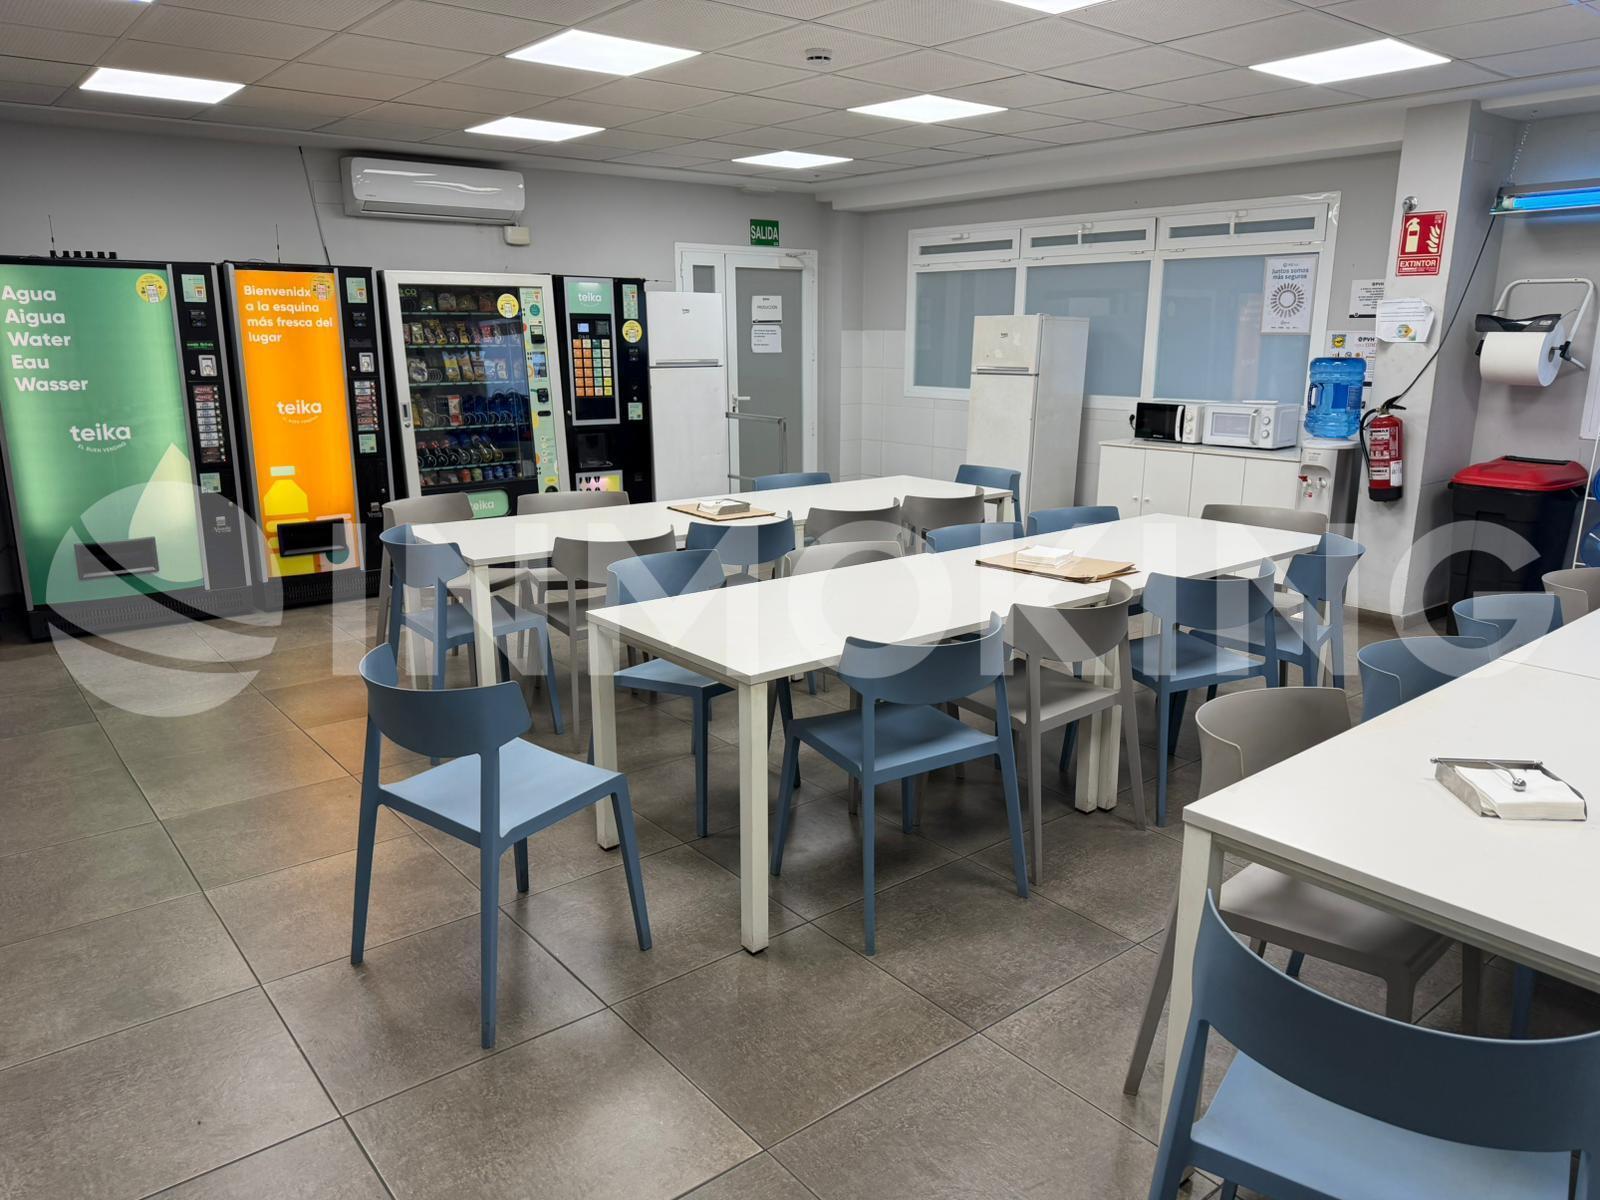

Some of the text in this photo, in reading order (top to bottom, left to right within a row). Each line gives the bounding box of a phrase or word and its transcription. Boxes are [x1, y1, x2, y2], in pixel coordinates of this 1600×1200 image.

[750, 225, 779, 241] SALIDA
[1399, 259, 1437, 269] EXTINTOR
[1284, 273, 1308, 281] seguros
[1, 285, 57, 305] Agua
[243, 284, 312, 297] Bienvenidx
[578, 292, 602, 302] teika
[245, 301, 320, 315] a la esquina
[4, 308, 66, 328] Aigua
[247, 317, 333, 328] más fresca del
[7, 331, 72, 347] Water
[248, 331, 282, 345] lugar
[11, 354, 50, 370] Eau
[14, 376, 89, 392] Wasser
[277, 399, 323, 415] teika
[69, 422, 131, 442] teika
[471, 500, 495, 511] eika
